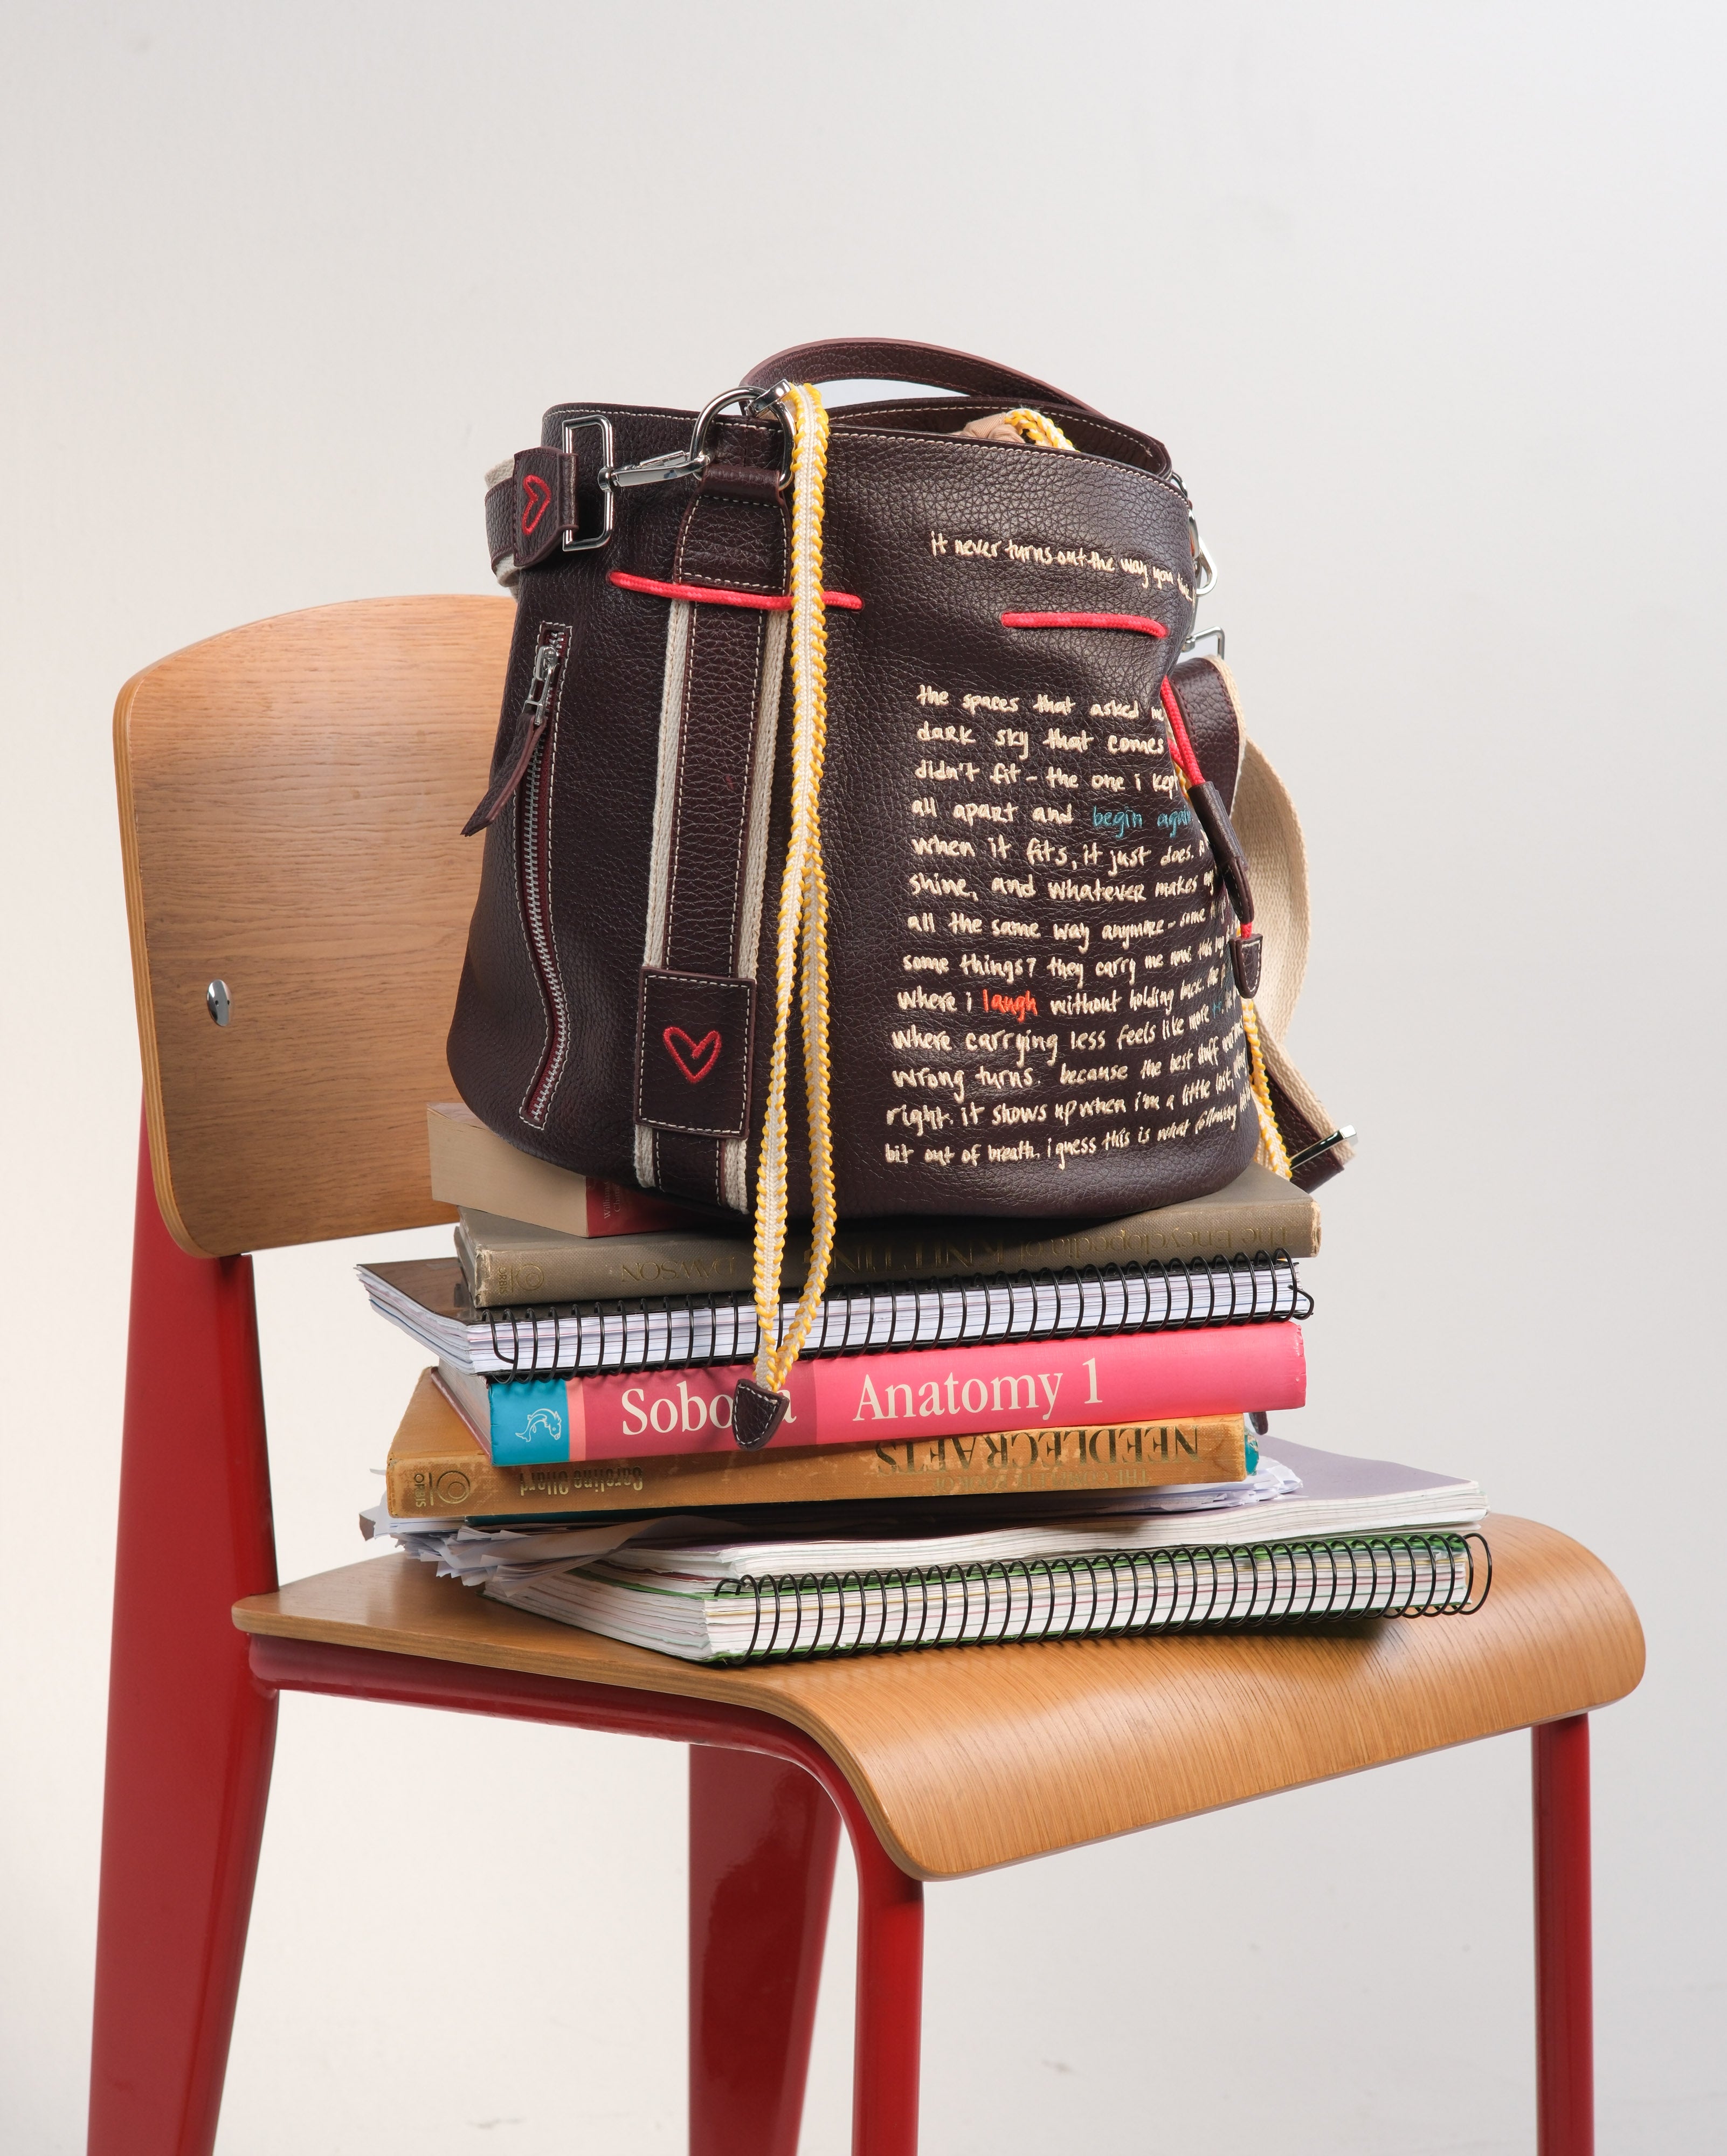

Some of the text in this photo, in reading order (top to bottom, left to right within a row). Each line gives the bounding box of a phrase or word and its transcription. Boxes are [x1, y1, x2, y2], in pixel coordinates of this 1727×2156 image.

[954, 538, 1003, 559] never
[1005, 538, 1051, 565] turns
[1054, 547, 1086, 567] out
[1085, 550, 1116, 572] the
[1120, 557, 1150, 590] way
[1152, 565, 1175, 591] you
[915, 683, 950, 707] the
[1032, 693, 1076, 716] that
[1089, 699, 1139, 720] asked
[916, 720, 1165, 761] dark sky that comes
[914, 758, 981, 783] didn't
[989, 762, 1022, 785] fit
[1045, 765, 1080, 789] the
[1090, 773, 1126, 792] one
[1134, 773, 1142, 792] i
[911, 796, 938, 818] all
[952, 801, 1019, 827] apart
[1032, 803, 1075, 825] and
[1092, 805, 1143, 839] begin
[986, 833, 1012, 860] it
[1082, 841, 1104, 866] it
[1107, 845, 1152, 877] just
[991, 873, 1037, 899] and
[1047, 877, 1147, 903] whatever
[1154, 874, 1199, 898] makes
[907, 911, 937, 933] all
[947, 910, 983, 935] the
[991, 918, 1042, 938] same
[1052, 922, 1090, 954] way
[902, 954, 950, 975] some
[1046, 956, 1084, 989] they
[1095, 956, 1137, 985] carry
[1144, 953, 1164, 970] me
[896, 984, 958, 1013] where
[965, 991, 972, 1013] i
[982, 988, 1039, 1024] laugh
[1049, 992, 1122, 1016] without
[1129, 985, 1175, 1016] holding
[891, 1024, 953, 1052] where
[964, 1028, 1059, 1069] carrying
[1070, 1029, 1106, 1051] less
[1116, 1020, 1157, 1051] feels
[1162, 1013, 1185, 1041] like
[892, 1067, 965, 1104] wrong
[1059, 1062, 1129, 1085] because
[1139, 1058, 1162, 1080] the
[1169, 1048, 1194, 1074] best
[959, 1100, 986, 1127] it
[991, 1102, 1047, 1126] shows
[1054, 1100, 1077, 1127] up
[1079, 1096, 1127, 1118] when
[1165, 1094, 1175, 1111] a
[1181, 1078, 1211, 1107] little
[885, 1143, 915, 1165] bit
[924, 1145, 956, 1166] out
[961, 1143, 982, 1167] of
[1055, 1136, 1097, 1171] guess
[1101, 1128, 1131, 1151] this
[1137, 1125, 1151, 1144] is
[1156, 1118, 1190, 1142] what
[621, 1257, 735, 1282] DAWSON
[802, 1227, 1289, 1275] The Encyclopedia of KNITTIN
[621, 1358, 1103, 1435] Soboa Anatomy 1
[875, 1426, 1202, 1478] NEEDLECRAFTS
[414, 1473, 426, 1508] ORBIS
[519, 1466, 644, 1496] Caroline Ollard
[931, 1476, 955, 1493] OF
[958, 1474, 1008, 1492] BOOK
[1113, 1468, 1150, 1486] THE
